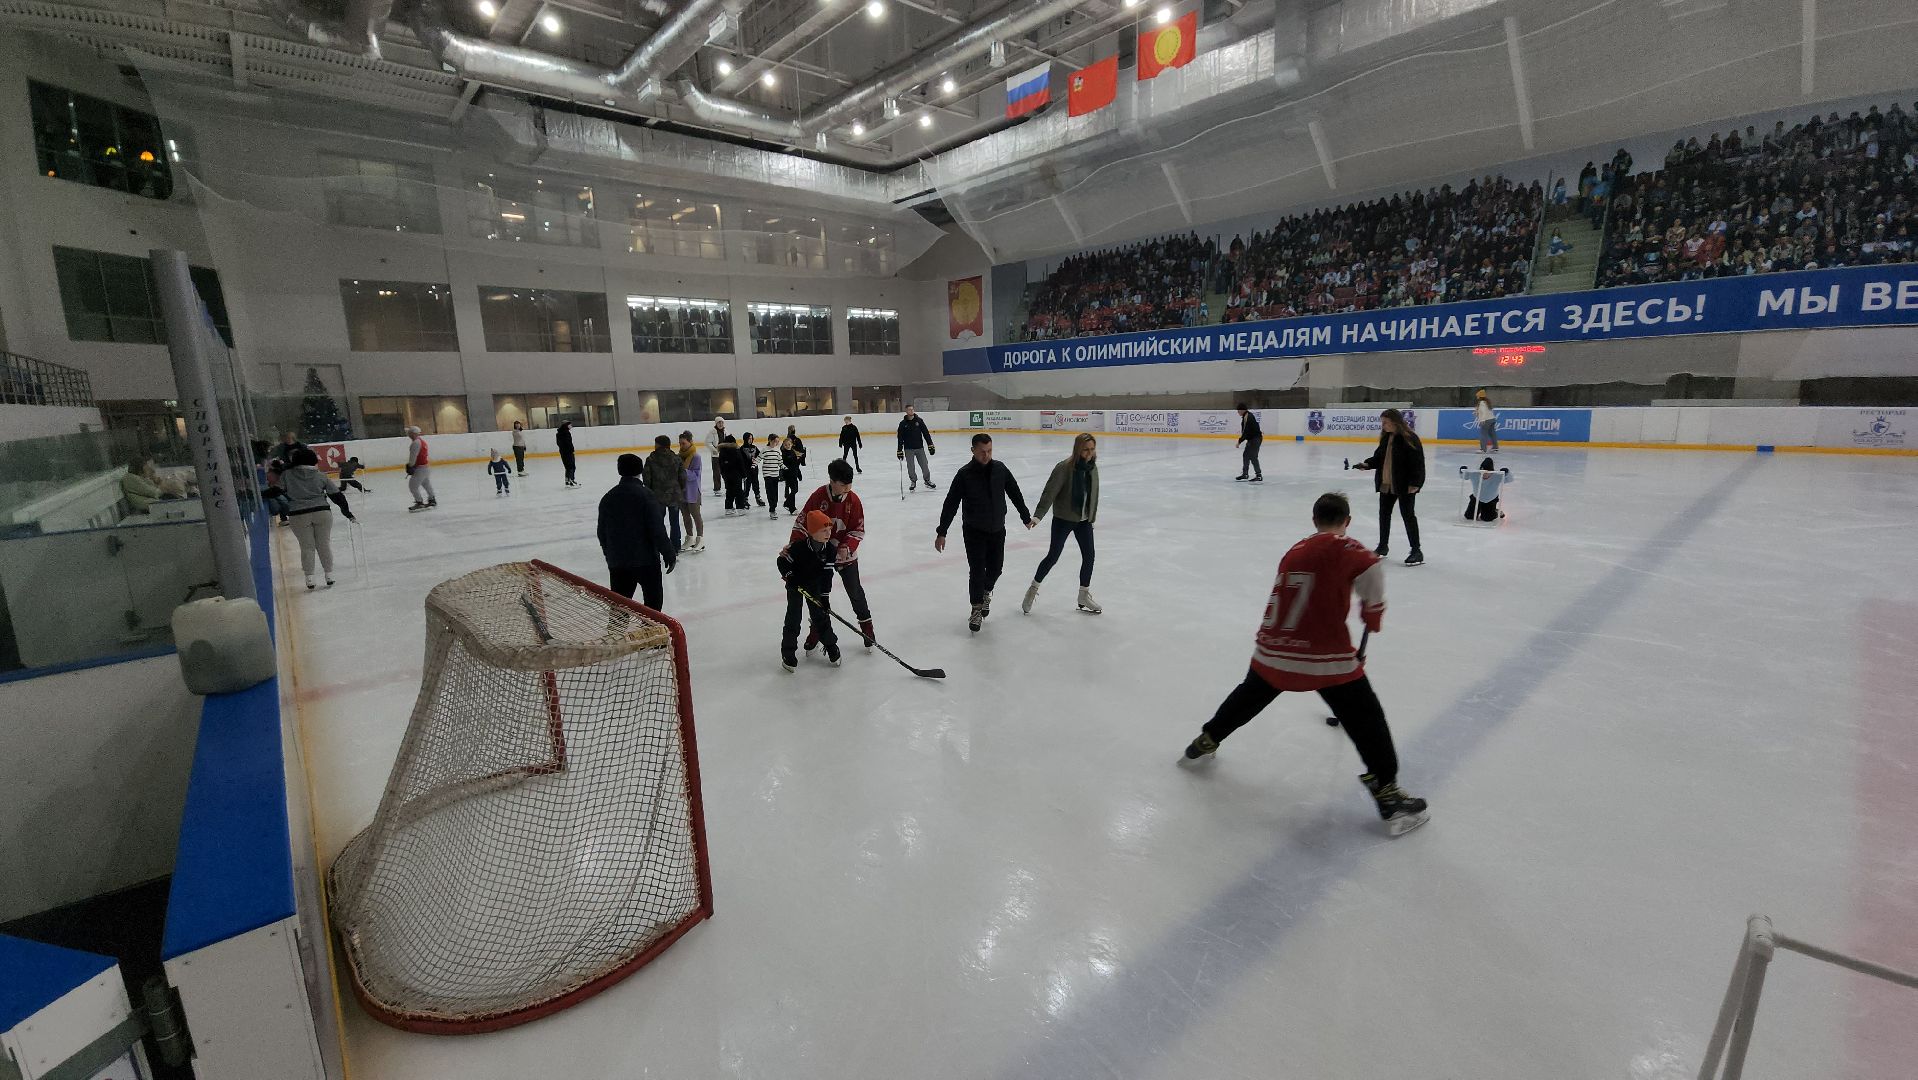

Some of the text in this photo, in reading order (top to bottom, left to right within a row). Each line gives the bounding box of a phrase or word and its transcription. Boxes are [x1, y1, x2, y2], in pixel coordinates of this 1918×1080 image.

[1757, 284, 1841, 317] МЫ
[1003, 294, 1707, 368] ДОРОГА К ОЛИМПИЙСКИМ МЕДАЛЯМ НАЧИНАЕТСЯ ЗДЕСЬ!
[1332, 415, 1366, 423] ФЕДЕРАЦИЯ
[1504, 418, 1560, 431] СПОРТОМ
